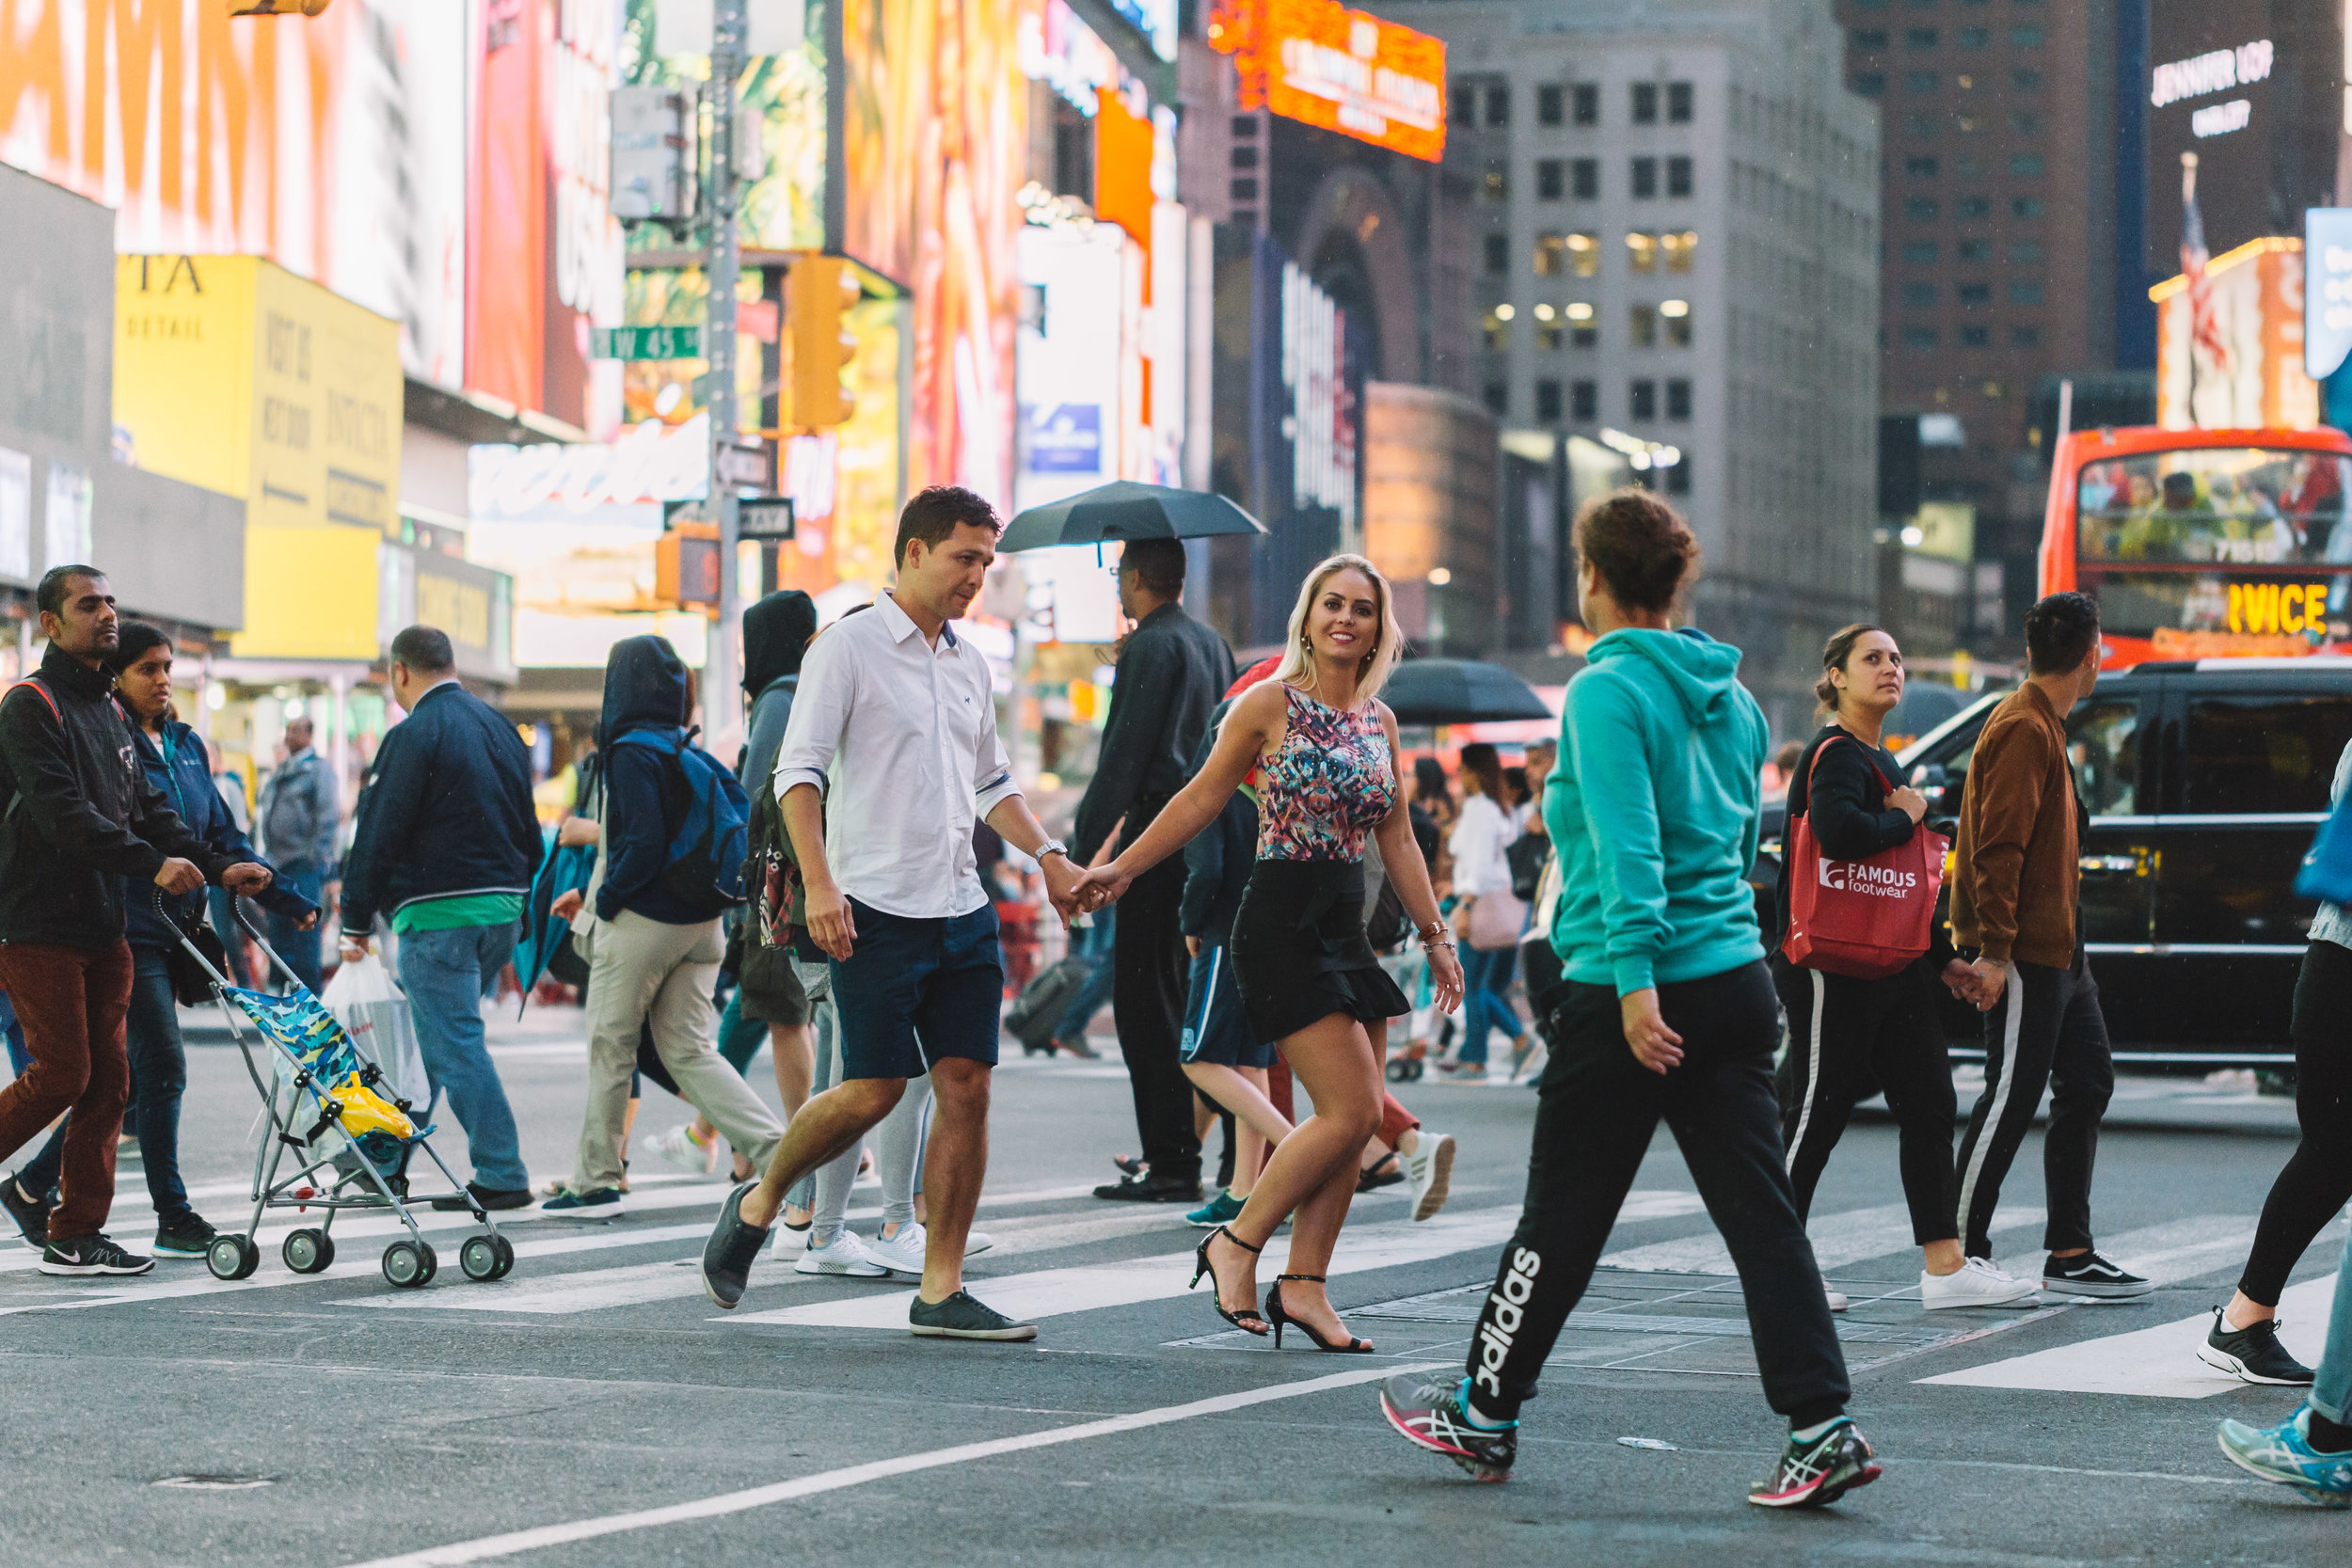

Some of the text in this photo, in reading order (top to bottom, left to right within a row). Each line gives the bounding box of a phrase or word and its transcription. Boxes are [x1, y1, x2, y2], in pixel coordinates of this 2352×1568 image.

[615, 330, 636, 357] W
[645, 329, 675, 357] 45
[1848, 863, 1916, 887] FAMOUS
[1849, 879, 1908, 899] footwear
[1476, 1246, 1541, 1398] adidas
